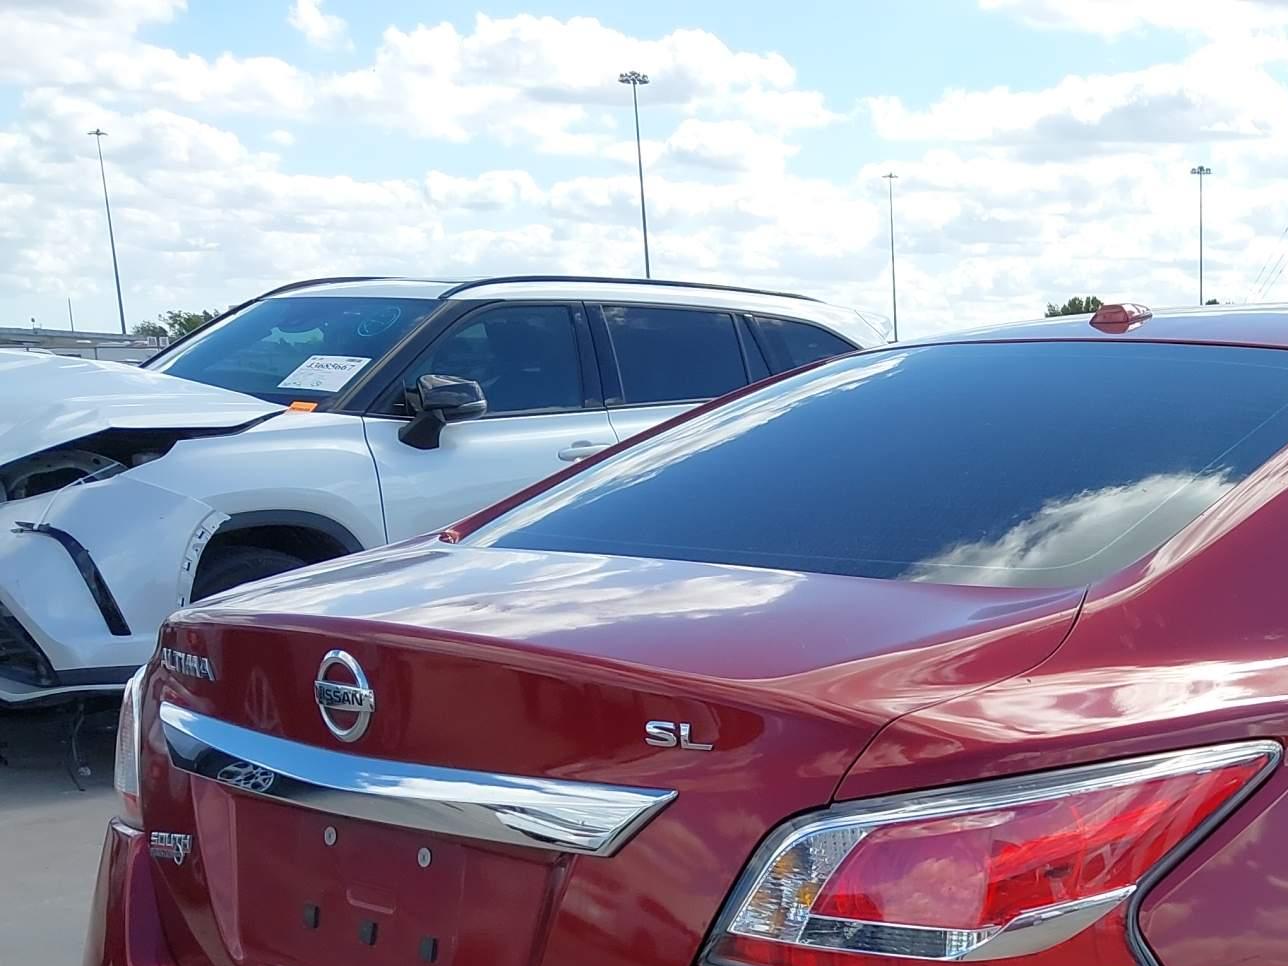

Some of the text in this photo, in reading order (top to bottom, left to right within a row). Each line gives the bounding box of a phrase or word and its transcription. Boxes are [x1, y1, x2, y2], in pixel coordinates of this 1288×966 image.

[160, 647, 216, 681] ALTIMA
[316, 682, 363, 707] NISSAN
[644, 720, 713, 750] SL
